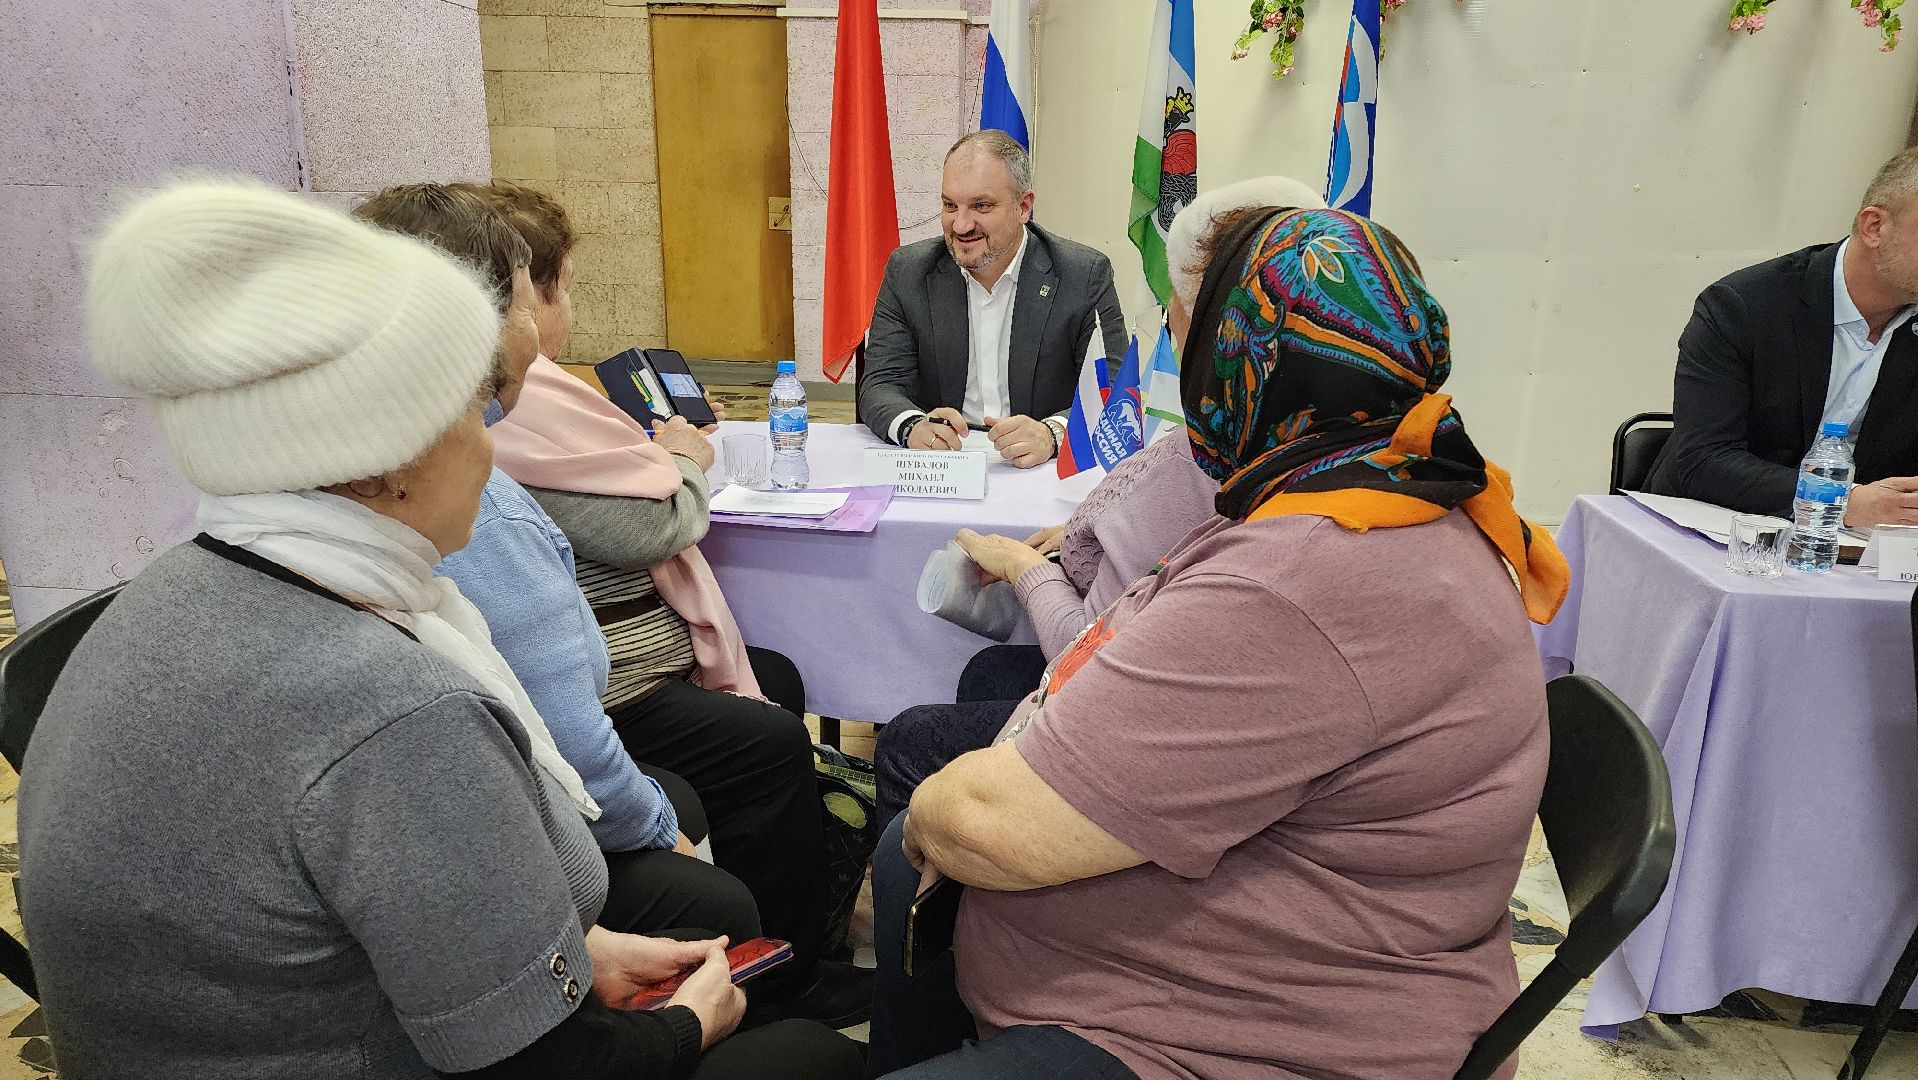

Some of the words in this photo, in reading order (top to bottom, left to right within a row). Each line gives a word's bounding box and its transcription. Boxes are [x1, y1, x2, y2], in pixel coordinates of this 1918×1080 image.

[1094, 425, 1118, 465] ОССИЯ
[896, 460, 949, 470] ШУВАЛОВ
[898, 472, 945, 482] МИХАИЛ
[893, 484, 957, 495] ИКОЛАЕВИЧ
